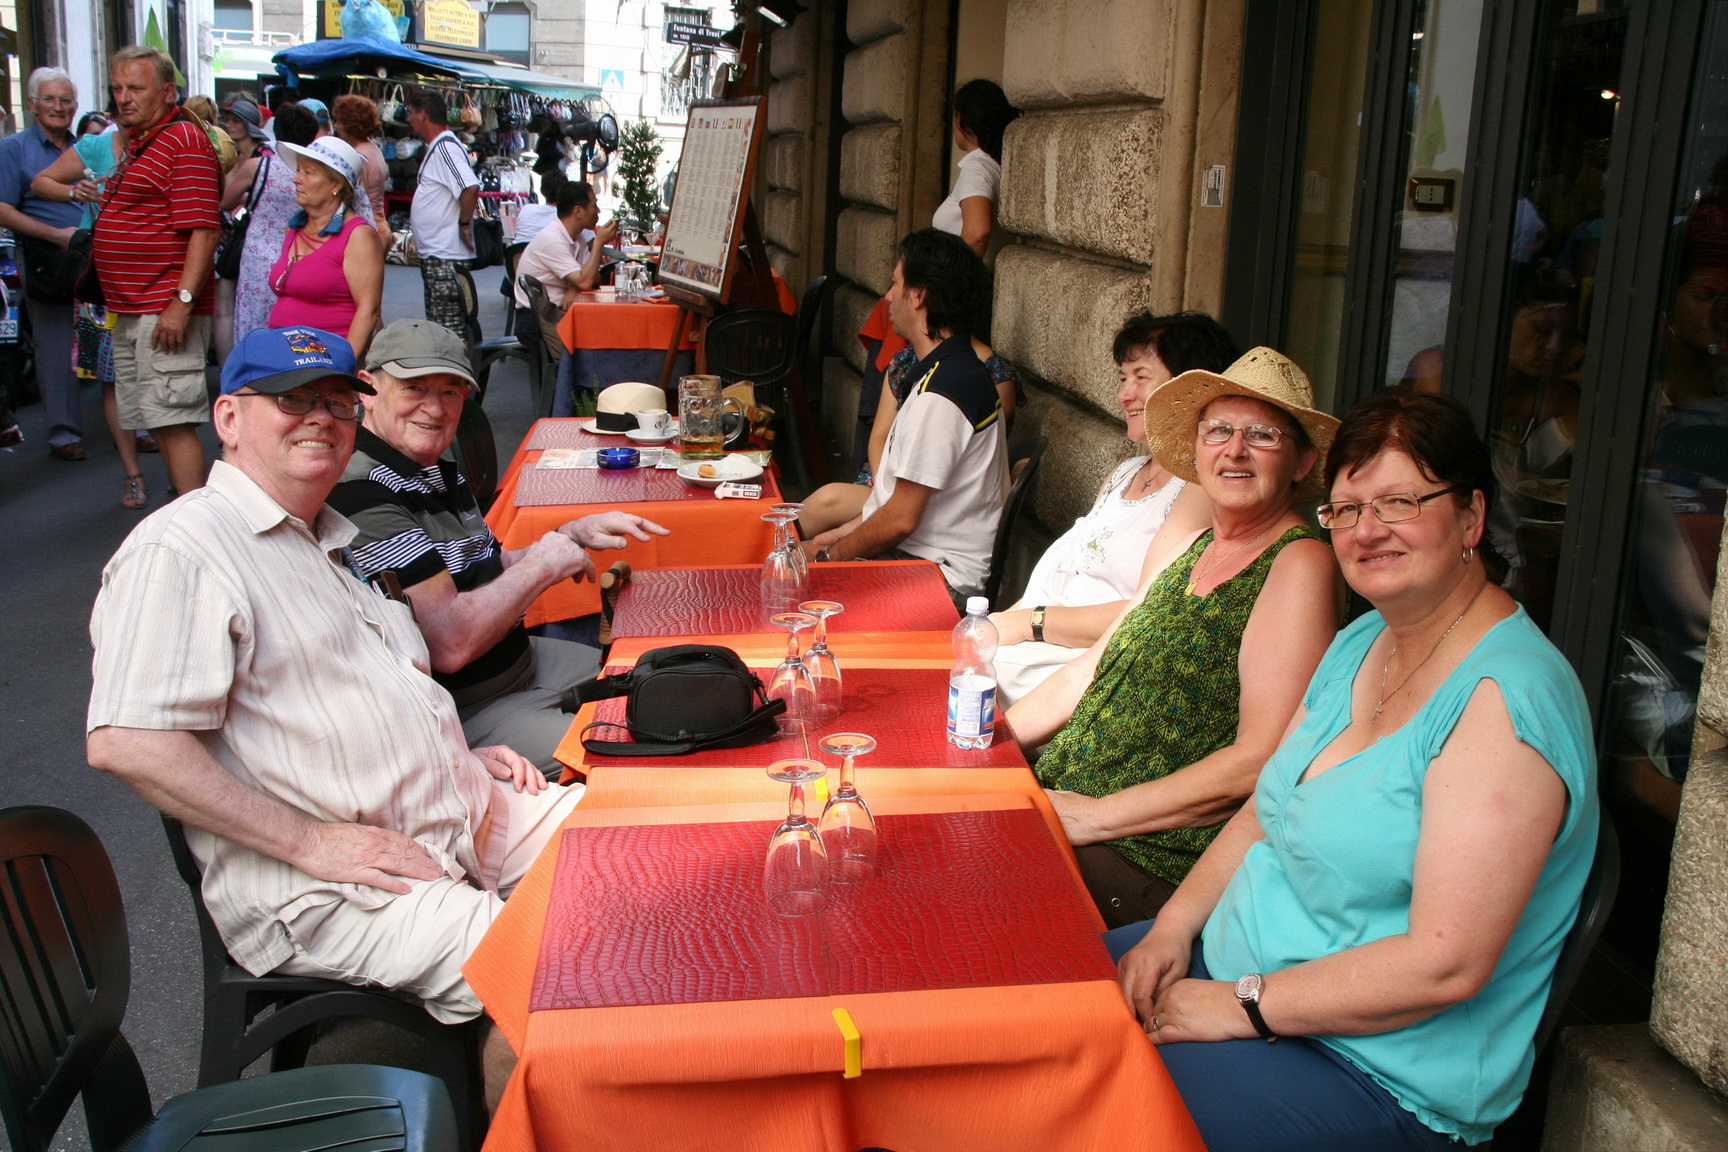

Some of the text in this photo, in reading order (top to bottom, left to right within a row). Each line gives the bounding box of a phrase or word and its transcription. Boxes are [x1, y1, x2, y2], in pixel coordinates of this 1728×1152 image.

[673, 24, 697, 34] Fontana
[706, 29, 720, 38] Trevi
[294, 356, 333, 366] THAILAND
